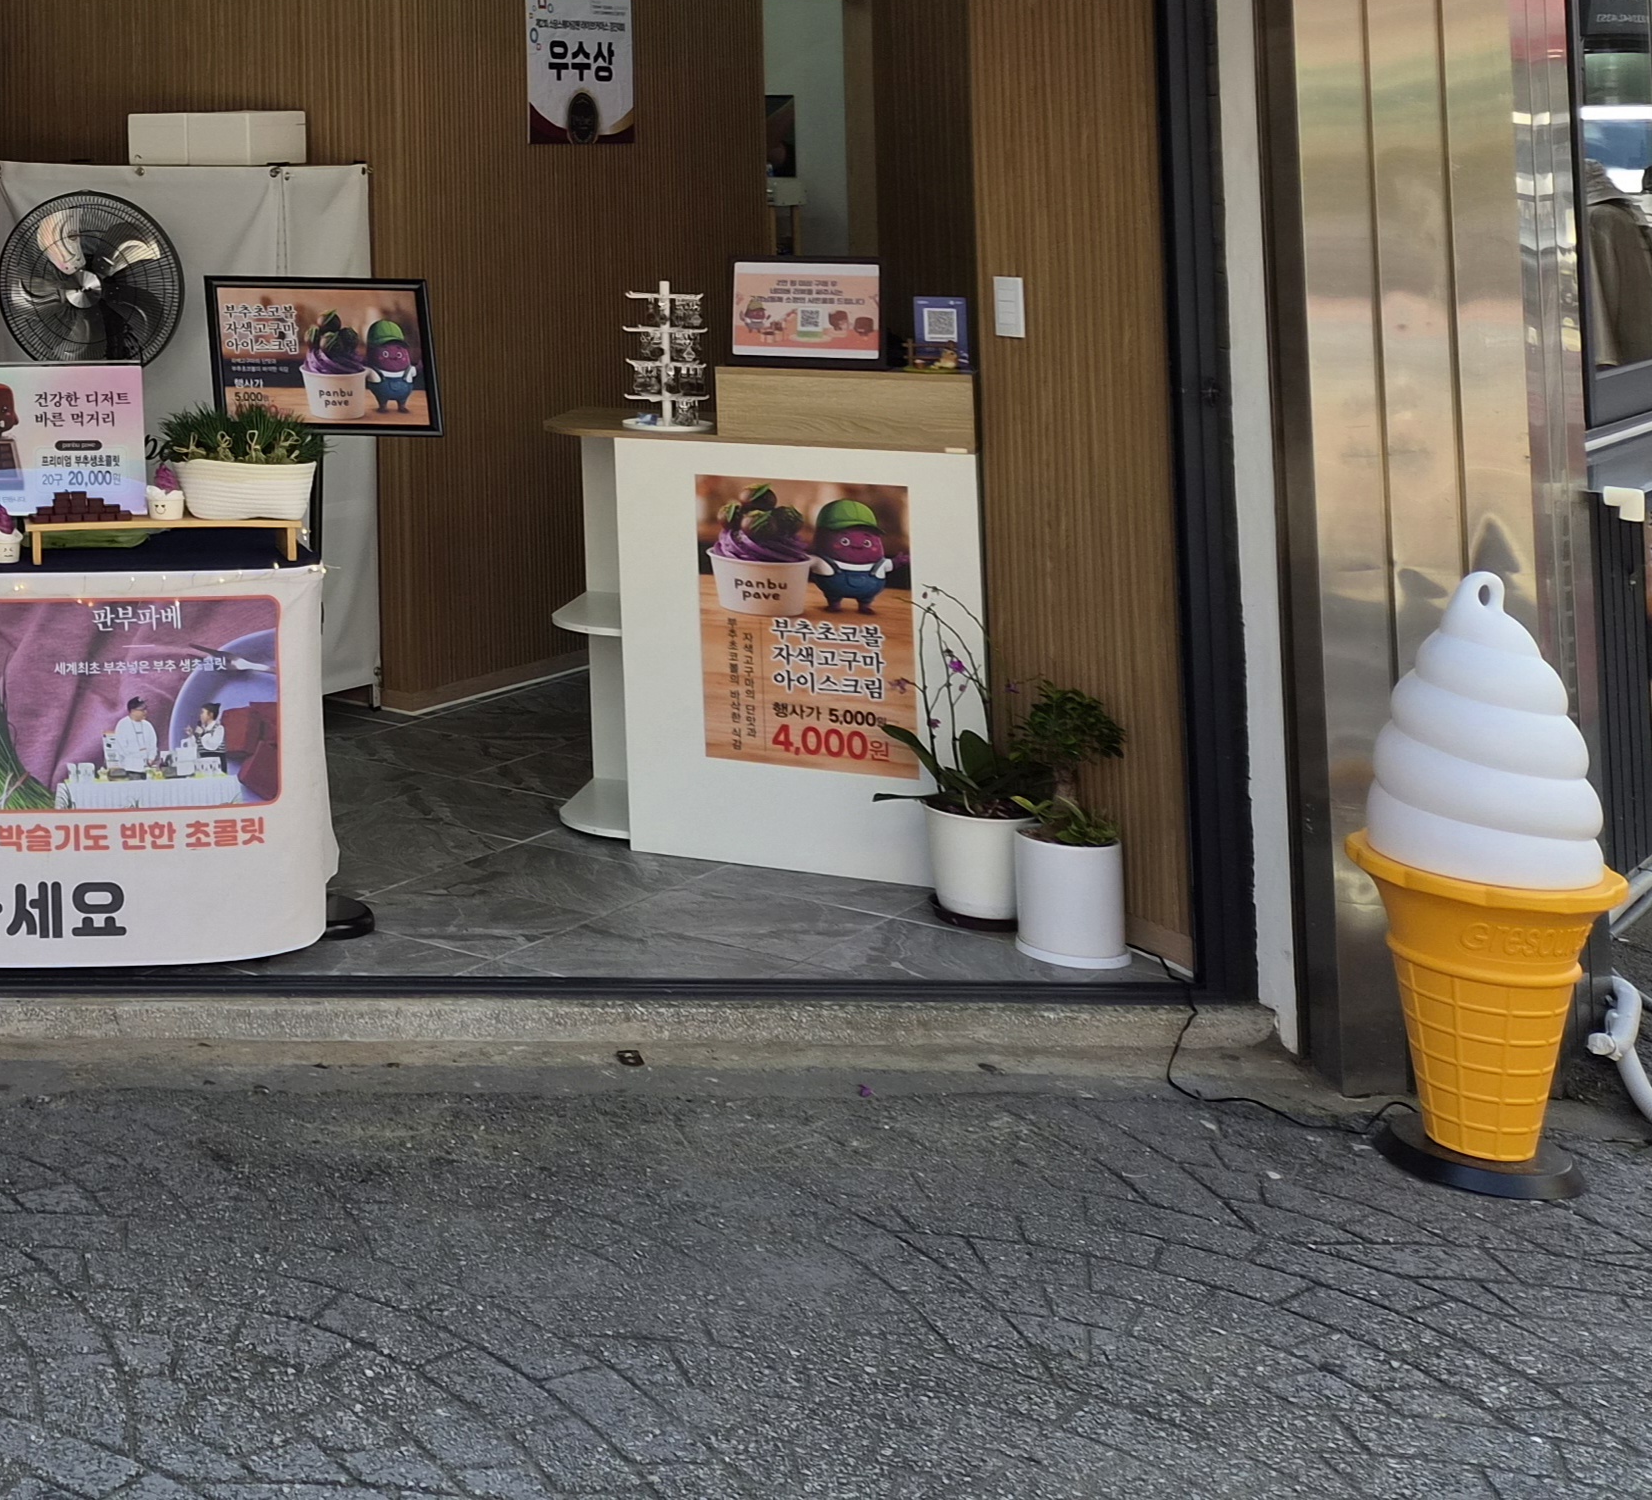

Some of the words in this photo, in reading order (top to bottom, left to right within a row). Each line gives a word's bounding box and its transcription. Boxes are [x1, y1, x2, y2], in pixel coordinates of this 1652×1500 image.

[548, 40, 615, 82] 우수상
[223, 304, 297, 319] 부추초코볼
[224, 321, 298, 336] 자색고구마
[226, 338, 299, 354] 아이스크림
[234, 378, 264, 389] 행사가
[34, 392, 80, 409] 건강한
[85, 392, 131, 407] 디저트
[318, 388, 353, 398] panbu
[324, 397, 350, 408] pave
[34, 411, 65, 428] 바른
[71, 411, 116, 427] 먹거리
[41, 455, 71, 467] 프리미엄
[42, 473, 63, 486] 20구
[68, 470, 121, 487] 20,000원
[734, 577, 788, 593] panbu
[742, 588, 781, 602] pave
[92, 604, 182, 632] 판부파베
[771, 618, 884, 648] 부추초코볼
[53, 660, 101, 675] 세계최초
[103, 660, 150, 675] 부추넣은
[152, 659, 176, 674] 부추
[178, 656, 227, 673] 생초콜릿
[772, 644, 885, 674] 자색고구마
[773, 669, 884, 700] 아이스크림
[772, 701, 822, 721] 행사가
[772, 723, 890, 762] 4,000원
[120, 821, 177, 851] 반한
[185, 817, 266, 849] 초콜릿
